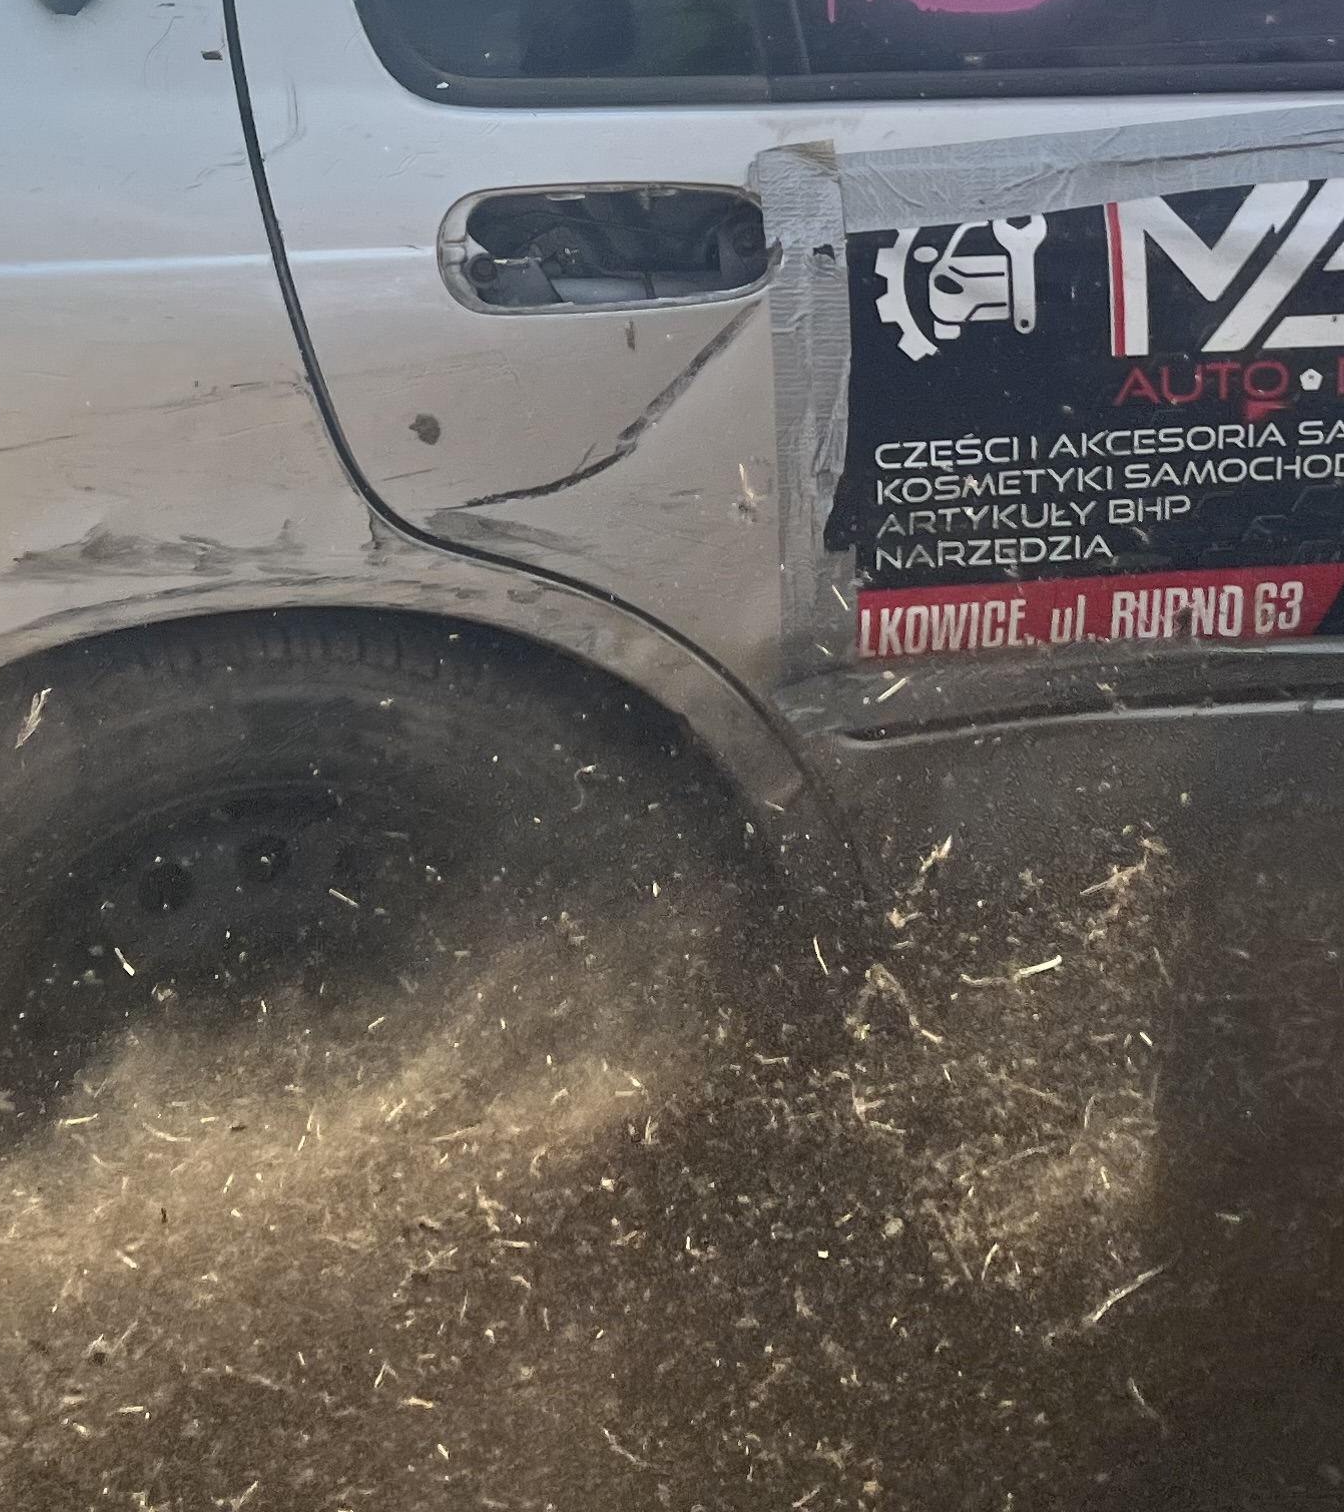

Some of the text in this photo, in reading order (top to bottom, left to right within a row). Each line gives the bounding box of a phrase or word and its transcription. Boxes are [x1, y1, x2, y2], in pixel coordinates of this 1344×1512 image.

[1114, 359, 1290, 406] AUTO
[874, 433, 1019, 472] CZĘŚCI
[1031, 435, 1038, 460] I
[1049, 423, 1286, 459] AKCESORIA
[876, 466, 1112, 505] KOSMETYKI
[876, 495, 1191, 539] ARTYKUŁY BHP
[1255, 581, 1303, 634] 63
